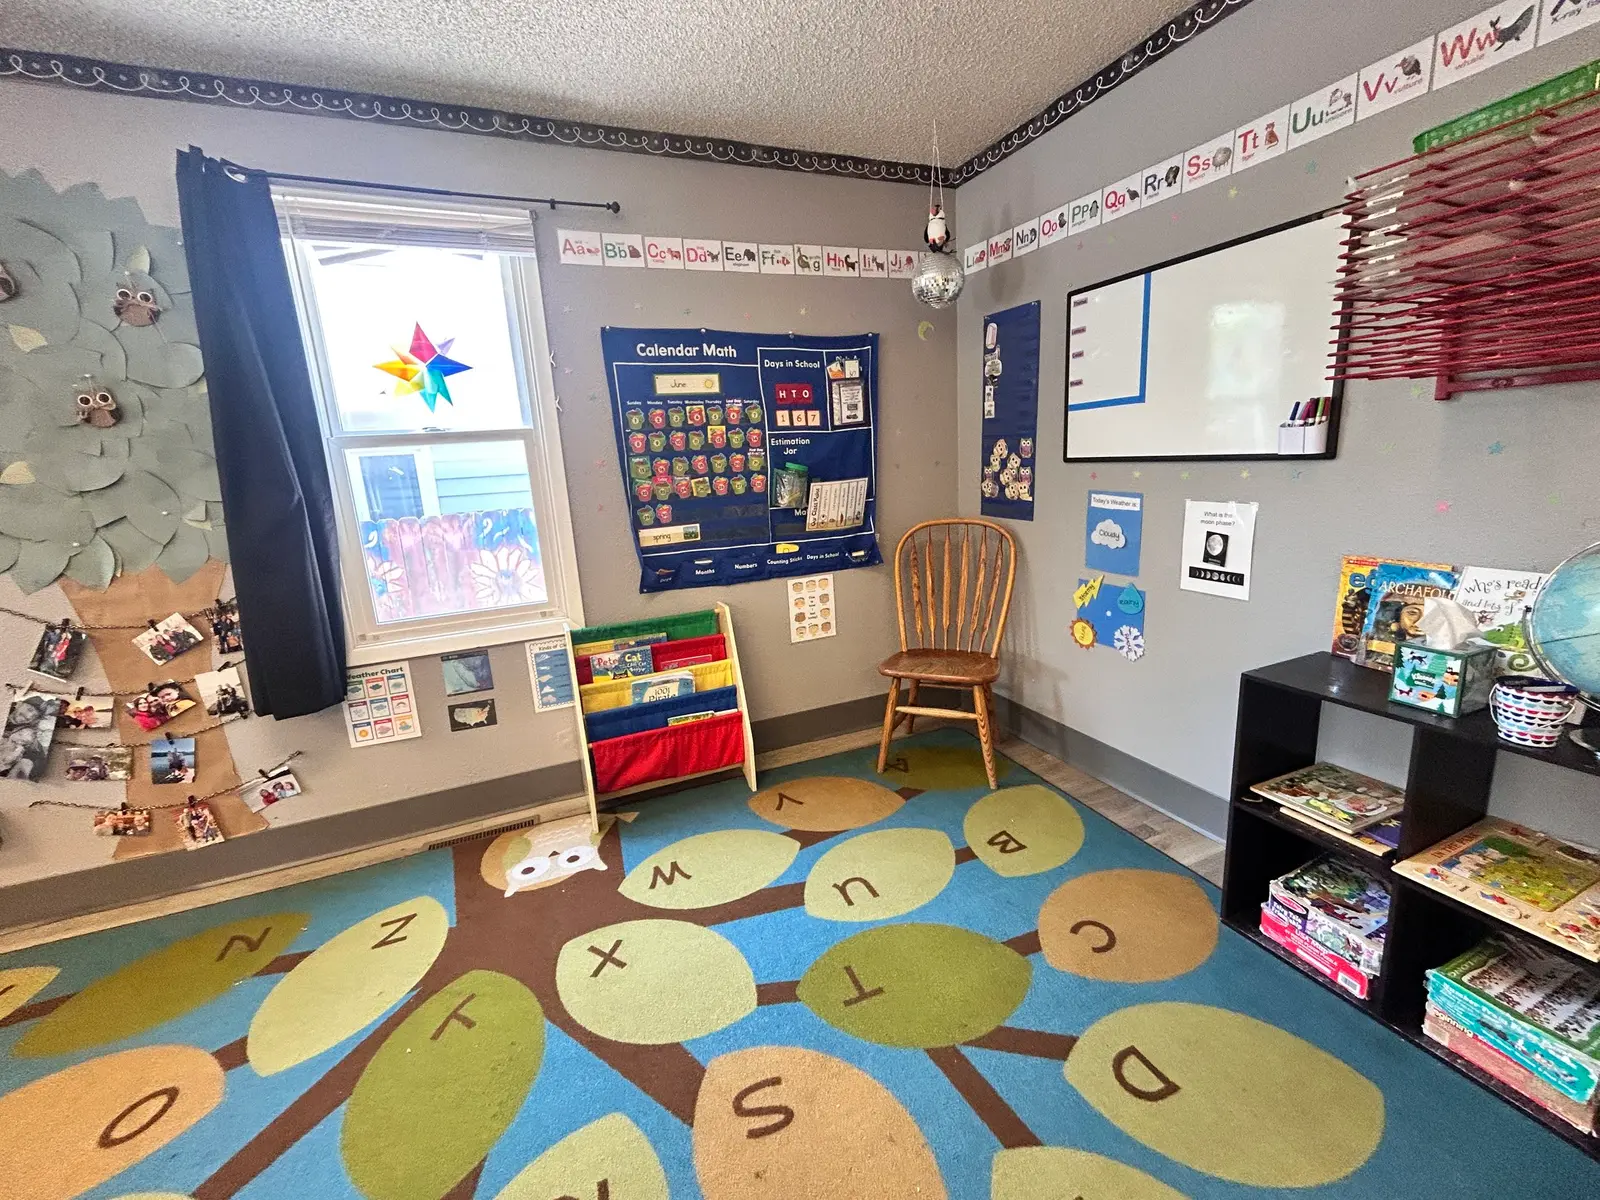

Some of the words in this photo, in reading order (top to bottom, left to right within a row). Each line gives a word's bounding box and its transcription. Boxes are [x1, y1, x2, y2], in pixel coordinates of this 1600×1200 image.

[1363, 72, 1398, 102] Vv
[1292, 106, 1324, 134] Uu
[1237, 128, 1259, 154] Tt
[1186, 154, 1211, 177] Ss
[1144, 173, 1164, 195] Rr
[1105, 190, 1126, 209] Qq
[1041, 219, 1058, 236] Oo
[1016, 229, 1029, 246] Nn
[562, 238, 586, 255] Aa
[604, 242, 628, 259] Bb
[647, 243, 667, 260] Cc
[724, 246, 742, 262] Ee
[989, 241, 1009, 257] Mm
[686, 247, 707, 263] Dd
[762, 250, 775, 266] Ff
[826, 252, 845, 268] Hh
[890, 253, 902, 270] Jj
[636, 342, 699, 357] Calendar
[702, 343, 737, 358] Math
[764, 359, 784, 369] Days
[795, 360, 820, 369] School
[670, 379, 687, 388] June
[779, 390, 787, 399] H
[791, 390, 797, 398] T
[802, 390, 810, 398] O
[796, 414, 802, 422] 6
[811, 414, 816, 422] 7
[770, 438, 810, 446] Estimation
[783, 447, 798, 455] Jar
[1092, 496, 1110, 505] Today's
[1110, 499, 1131, 507] Weather
[653, 533, 671, 543] spring
[1098, 529, 1120, 541] Cloudy
[824, 551, 840, 559] School
[734, 562, 758, 570] Numbers
[1379, 580, 1456, 600] ARCHAEOL
[1464, 578, 1502, 594] who's
[1507, 576, 1543, 590] read
[1119, 599, 1139, 609] Rainy
[1461, 598, 1483, 608] and
[597, 657, 618, 666] Pete
[624, 653, 642, 662] Cat
[380, 666, 404, 675] Chart
[655, 687, 670, 695] 1001
[986, 830, 1028, 855] B
[1069, 919, 1118, 954] C
[587, 939, 627, 978] X
[842, 965, 885, 1008] T
[1111, 1045, 1181, 1102] D
[732, 1076, 795, 1140] S
[97, 1086, 181, 1149] O
